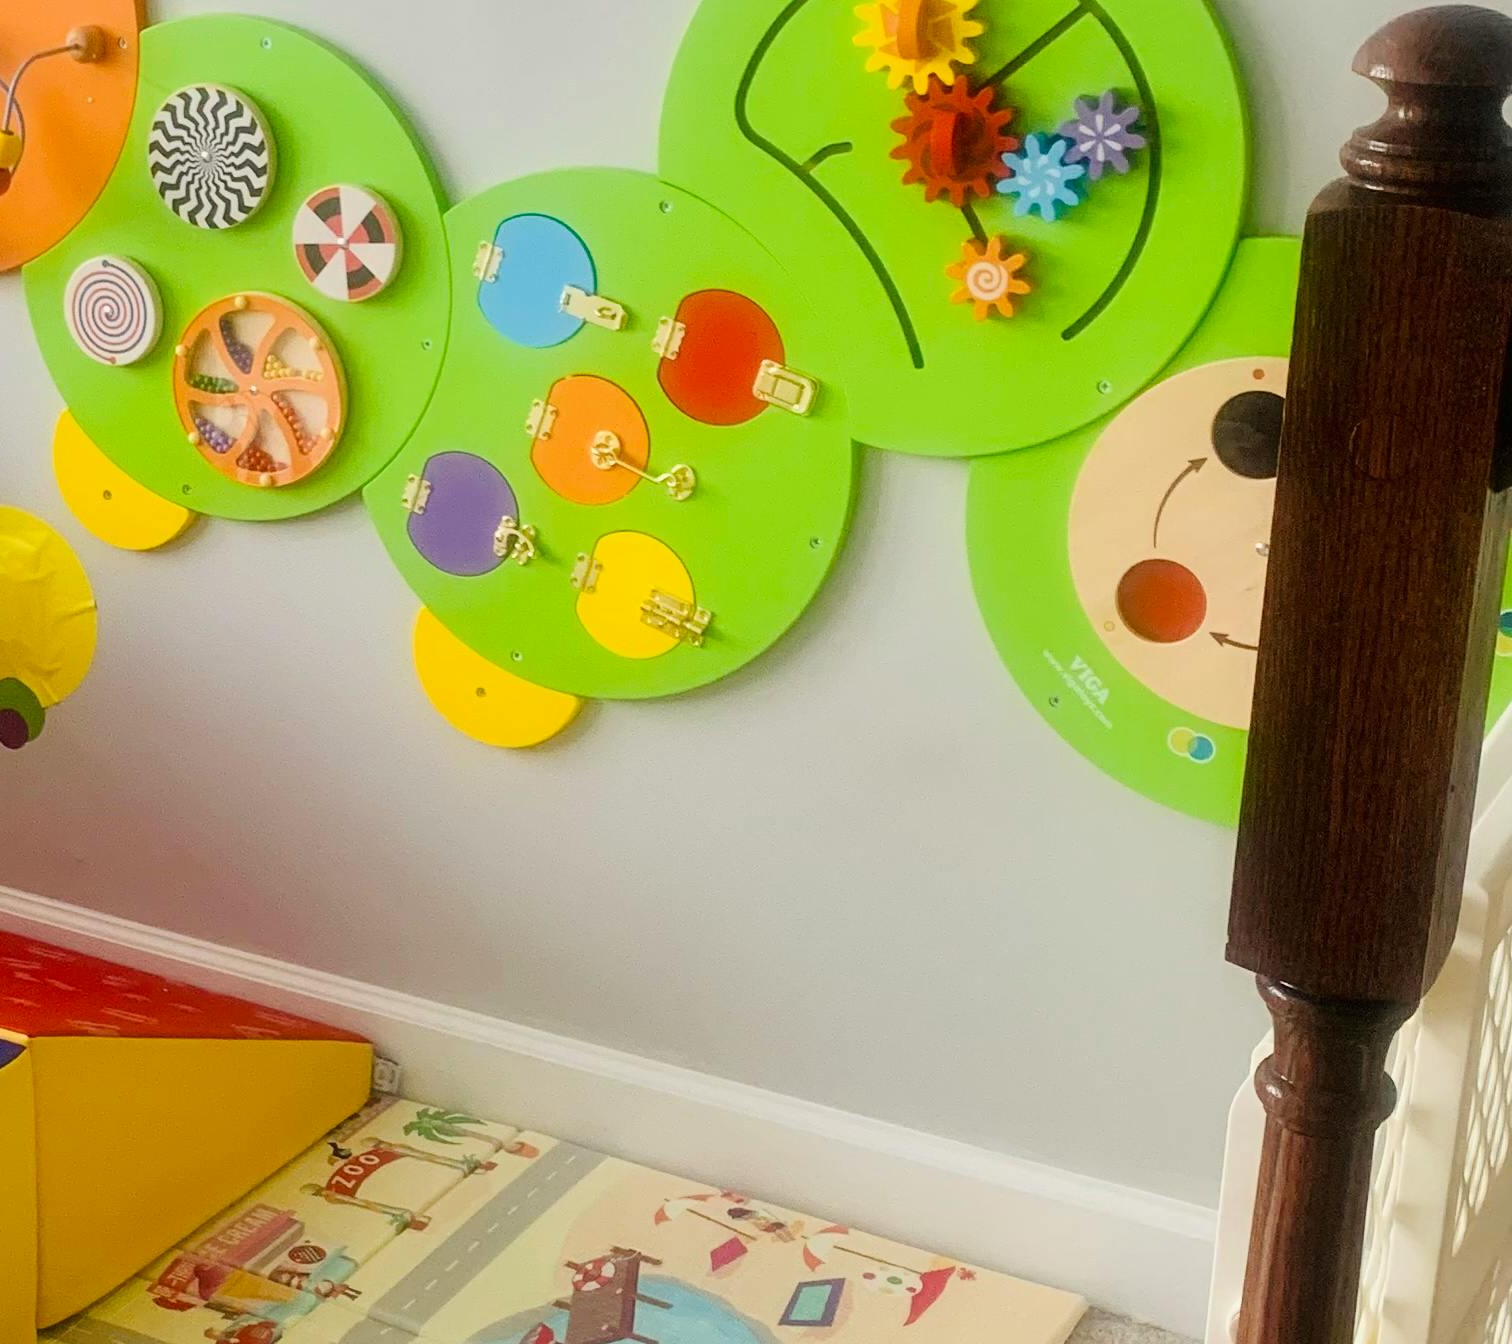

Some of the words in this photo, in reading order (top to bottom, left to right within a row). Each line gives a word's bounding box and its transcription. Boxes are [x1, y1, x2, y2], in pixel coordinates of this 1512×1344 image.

[1070, 655, 1109, 704] VIGA
[331, 1154, 381, 1189] ZOO
[216, 1207, 279, 1246] CREAM
